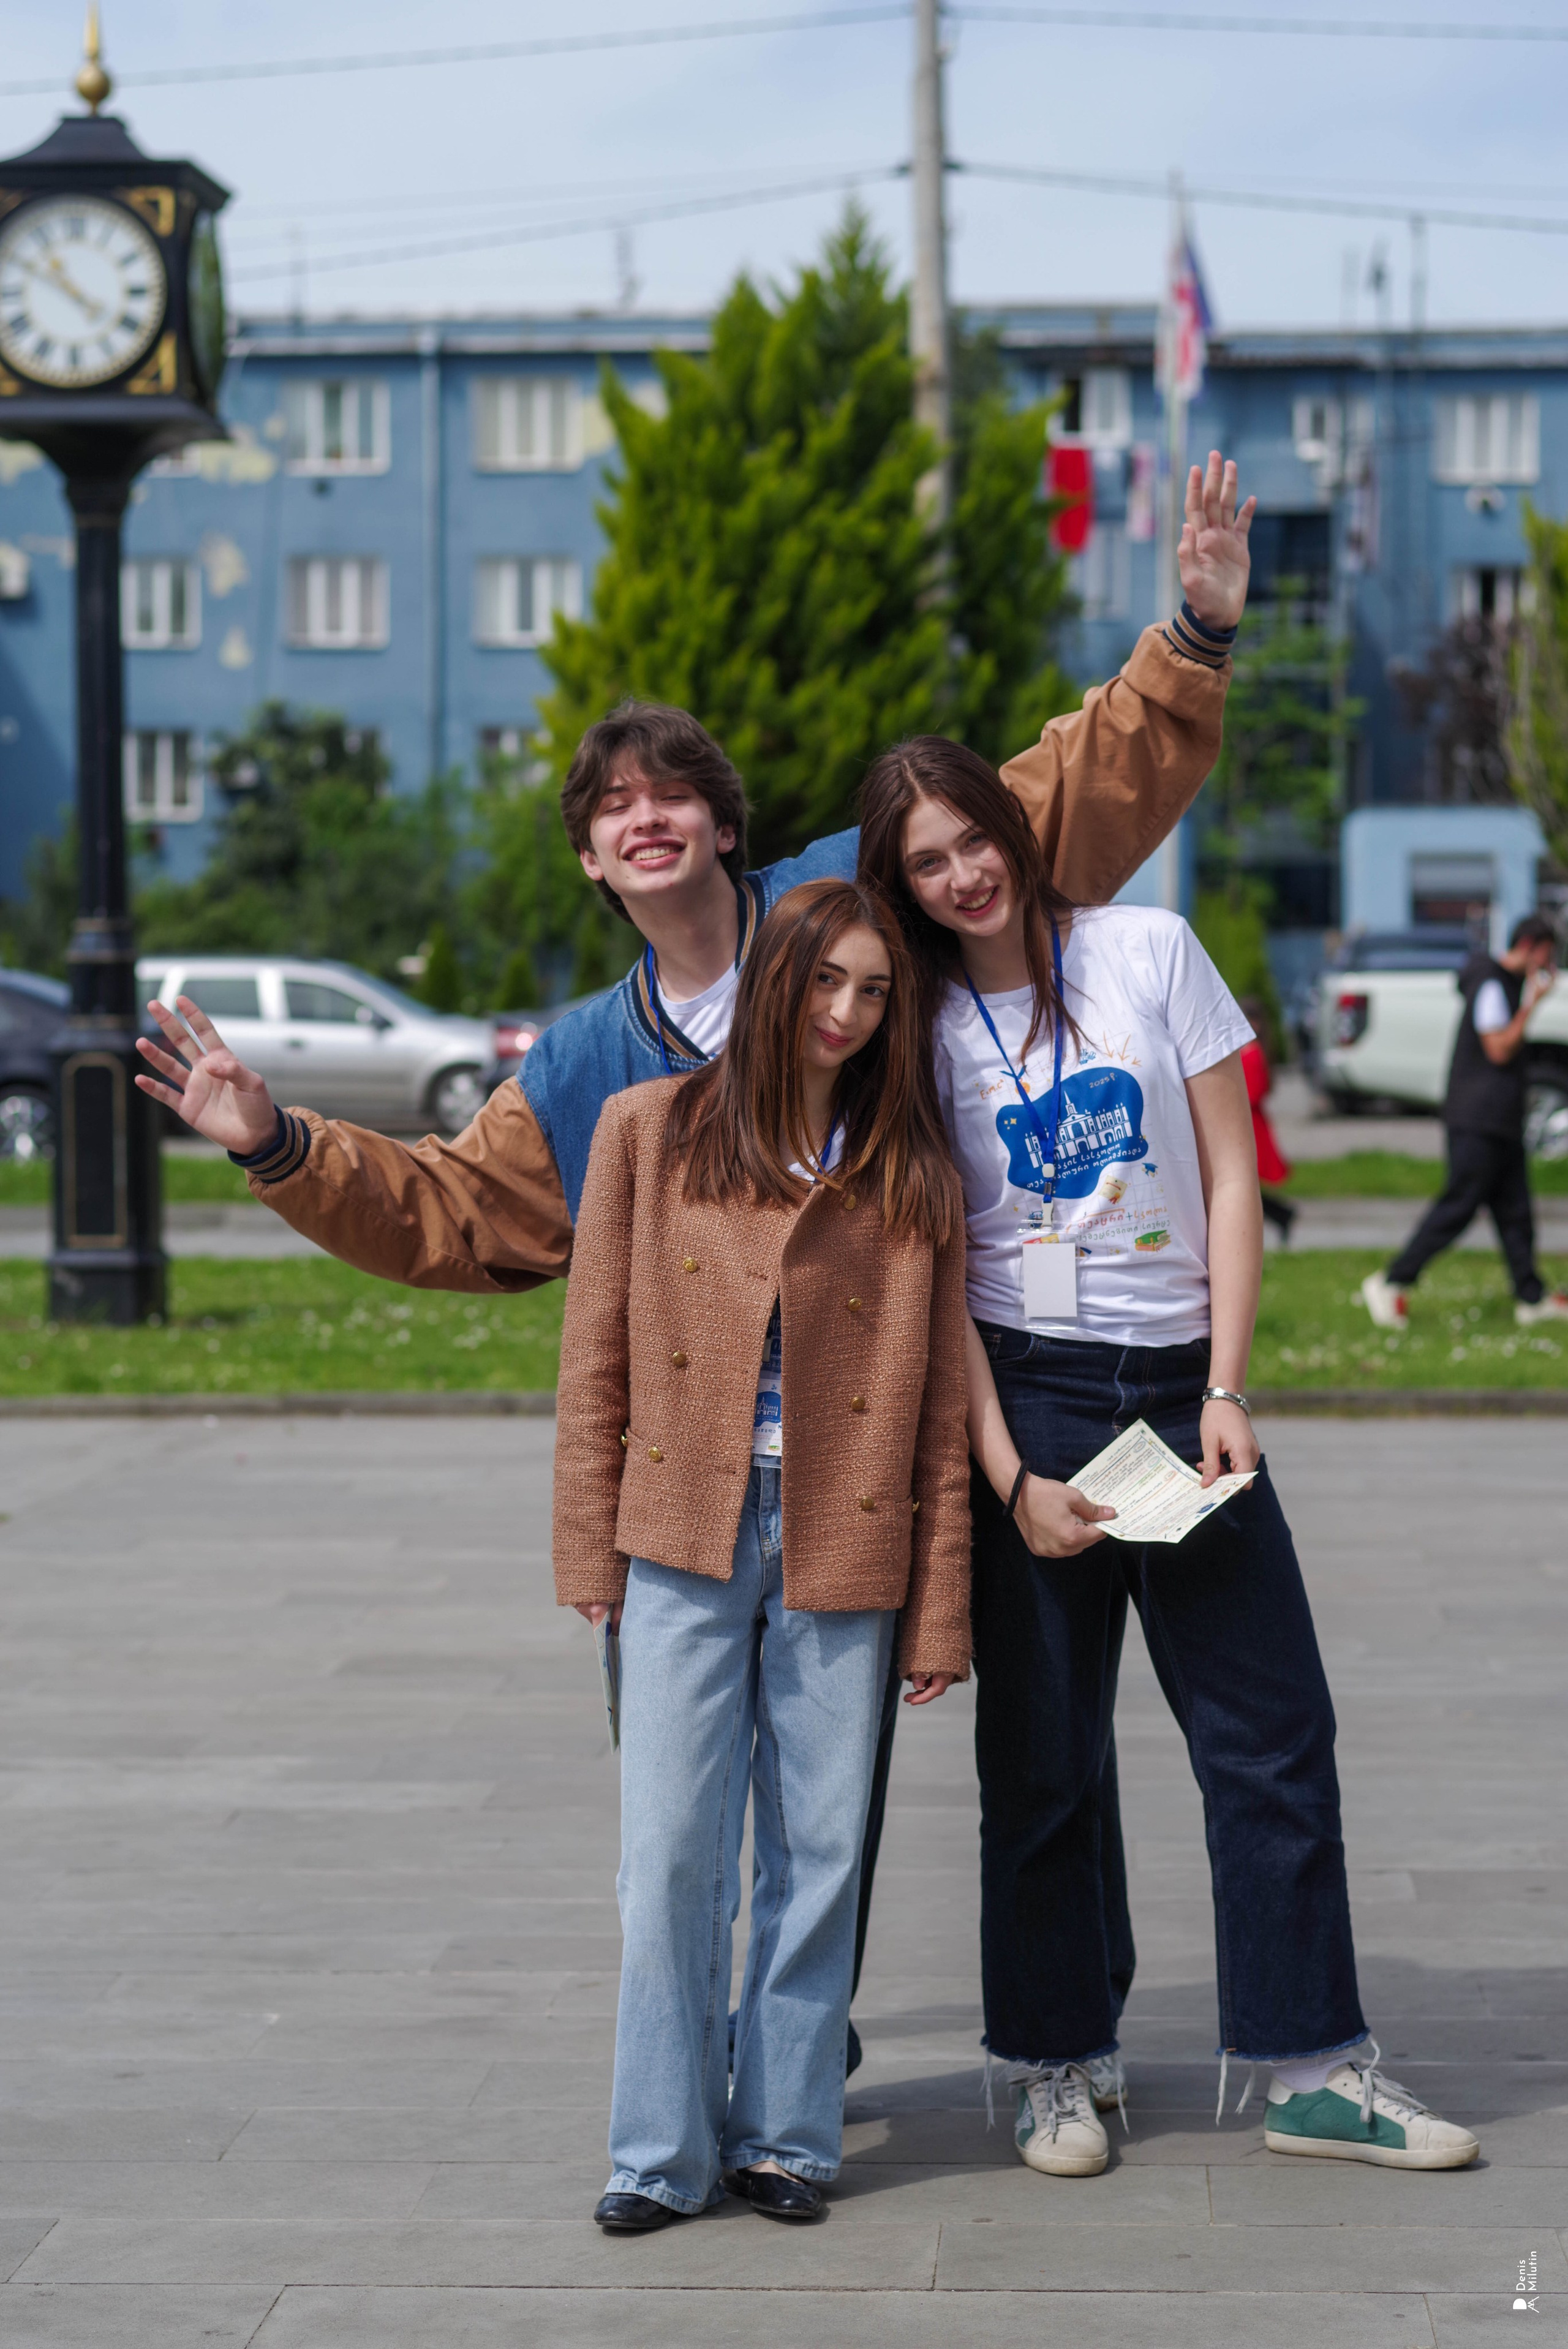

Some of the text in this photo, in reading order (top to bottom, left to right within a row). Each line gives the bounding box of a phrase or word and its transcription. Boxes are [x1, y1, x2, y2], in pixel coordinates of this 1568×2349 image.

[1027, 1147, 1141, 1188] თეაალური ოლიმპიადა
[1054, 1144, 1120, 1171] აკის სასკოლო
